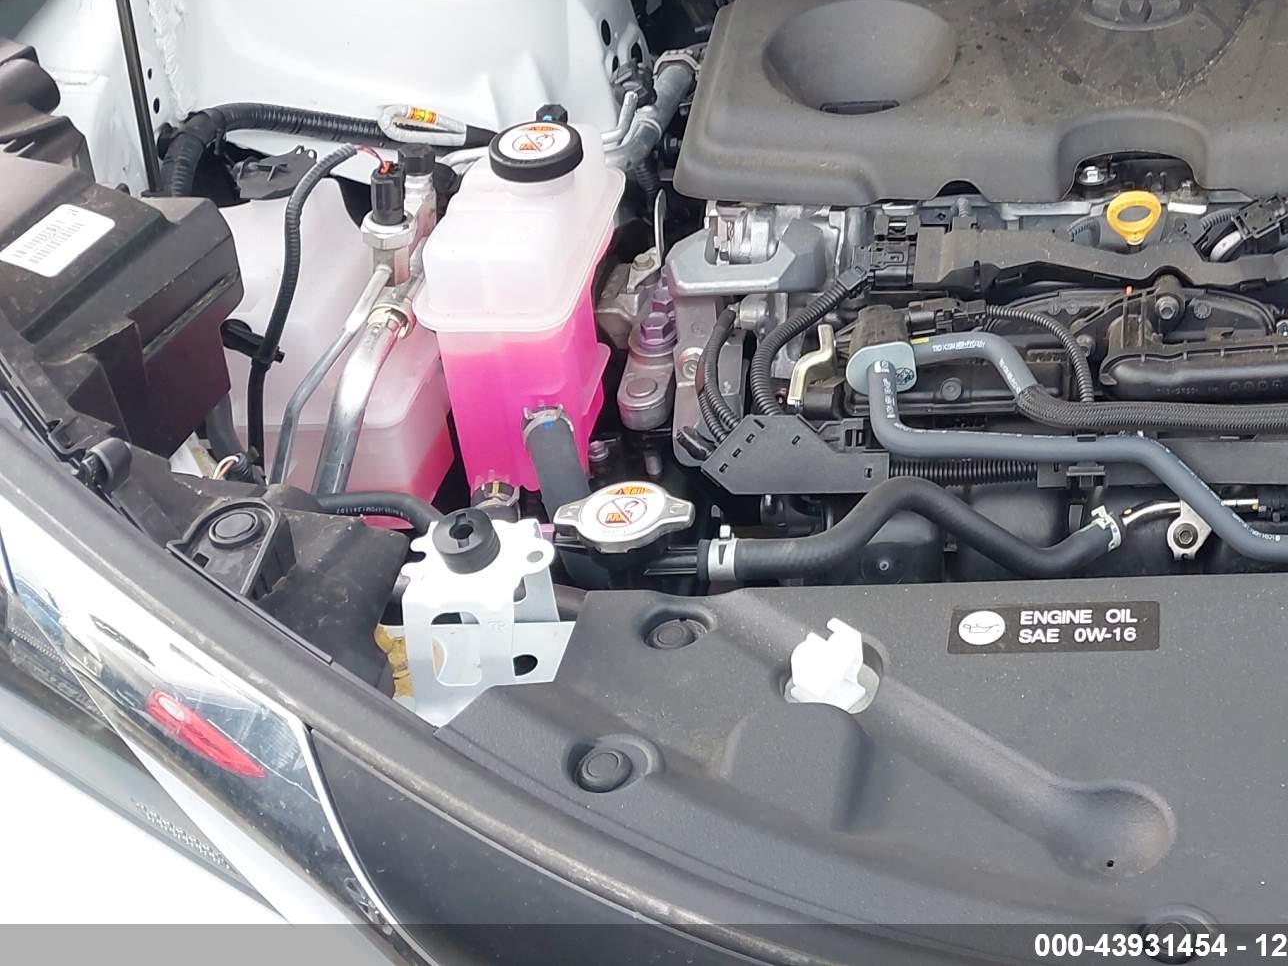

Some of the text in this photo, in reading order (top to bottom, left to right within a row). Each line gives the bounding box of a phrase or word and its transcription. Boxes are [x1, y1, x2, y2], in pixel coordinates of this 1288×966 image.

[1019, 608, 1138, 626] ENGINE OIL
[1018, 627, 1137, 644] SAE 0W-16
